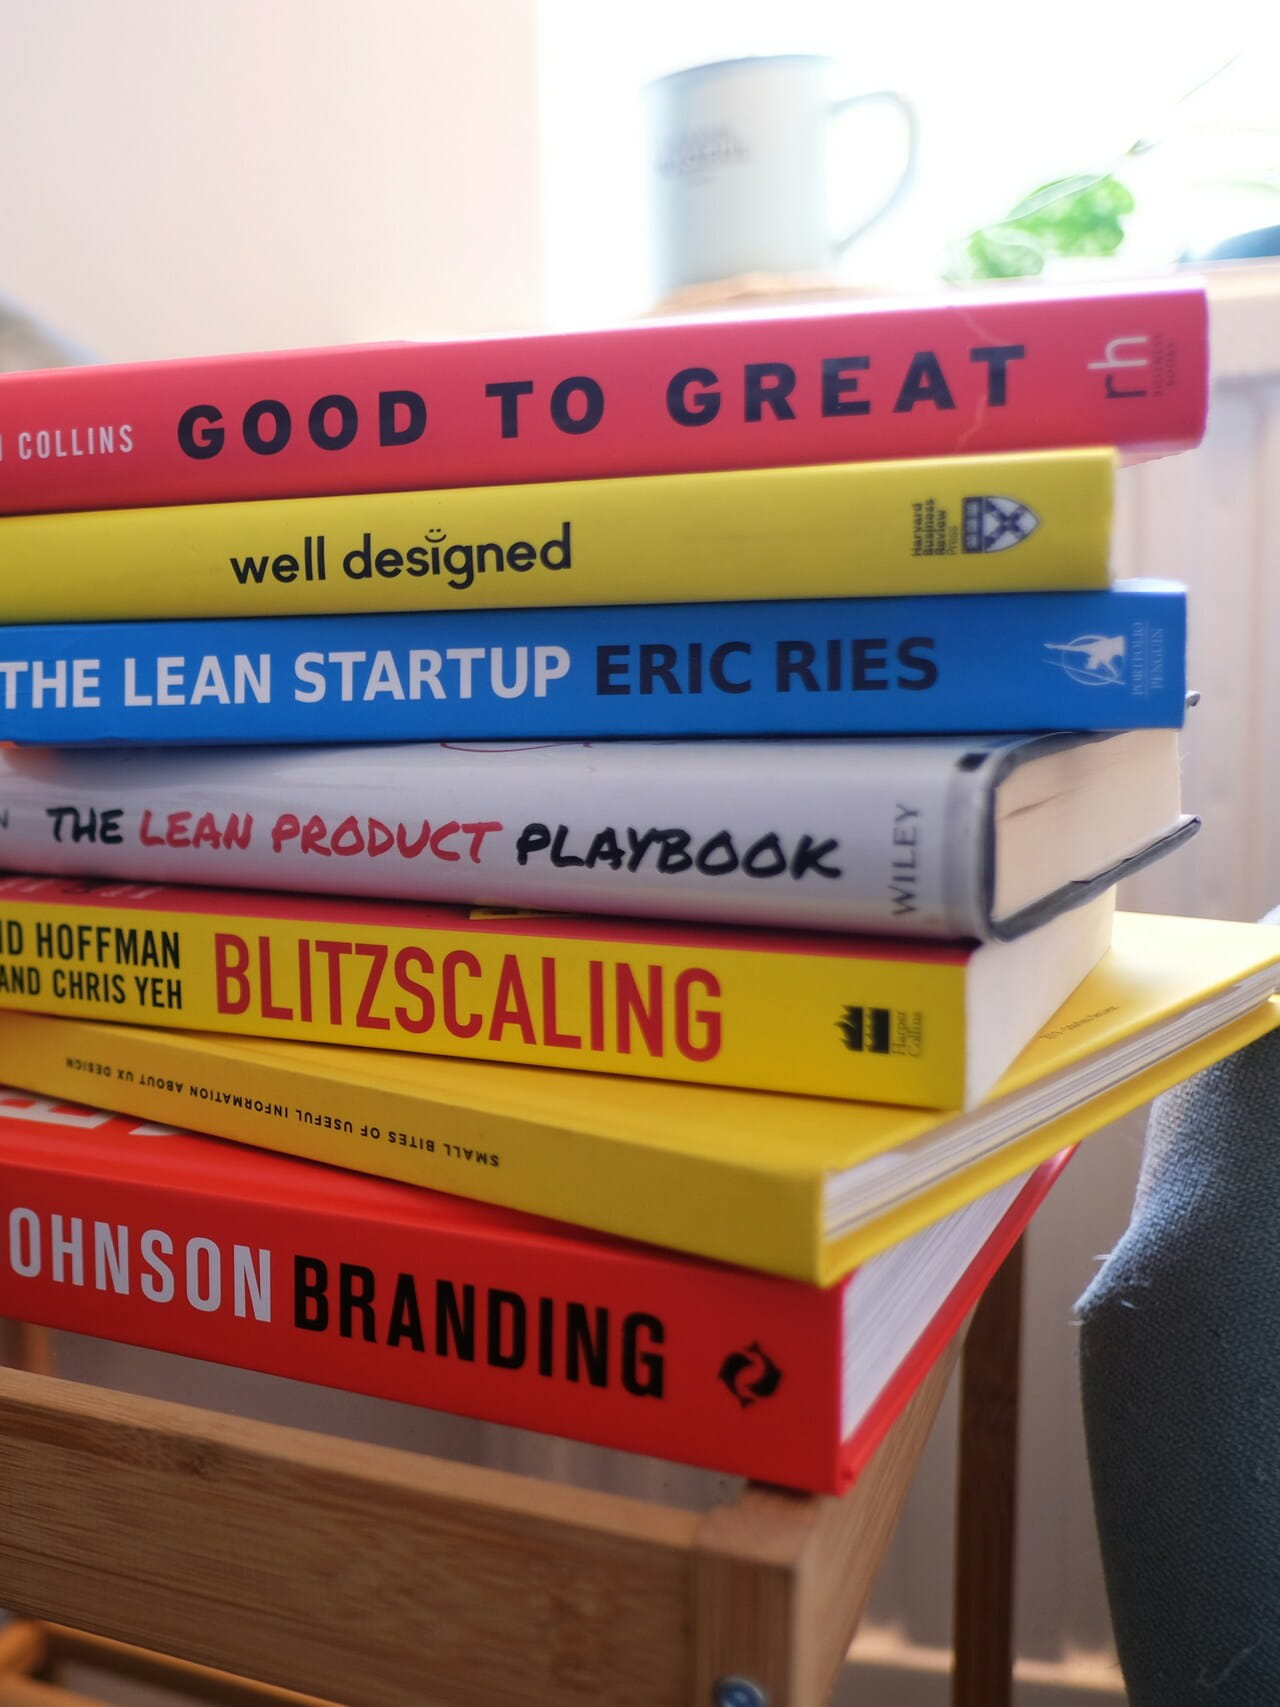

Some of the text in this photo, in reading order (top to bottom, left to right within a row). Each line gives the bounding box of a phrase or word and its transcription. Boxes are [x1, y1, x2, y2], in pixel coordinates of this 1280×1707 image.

[1087, 335, 1149, 399] rh
[178, 345, 1025, 460] GOOD TO GREAT
[19, 425, 133, 459] COLLINS
[230, 522, 571, 589] well designed
[911, 503, 922, 556] Harvard
[923, 499, 934, 556] Business
[935, 510, 946, 556] Review
[125, 654, 270, 706] LEAN
[295, 646, 570, 703] STARTUP
[597, 637, 938, 695] ERIC RIES
[1131, 622, 1144, 697] PORTFOLIO
[1151, 629, 1163, 688] PENGUIN
[47, 806, 842, 879] THE LEAN PRODUCT PLAYBOOK
[889, 804, 922, 915] WILEY
[36, 923, 179, 969] HOFFMAN
[53, 969, 125, 1004] CHRIS
[135, 976, 181, 1009] YEH
[214, 933, 722, 1063] BLITZSCALING
[891, 1010, 908, 1056] Harper
[66, 1058, 499, 1167] SMALL BITES OF USEFUL INFORMATION ABOUT UX DESIGN
[294, 1254, 665, 1399] BRANDING
